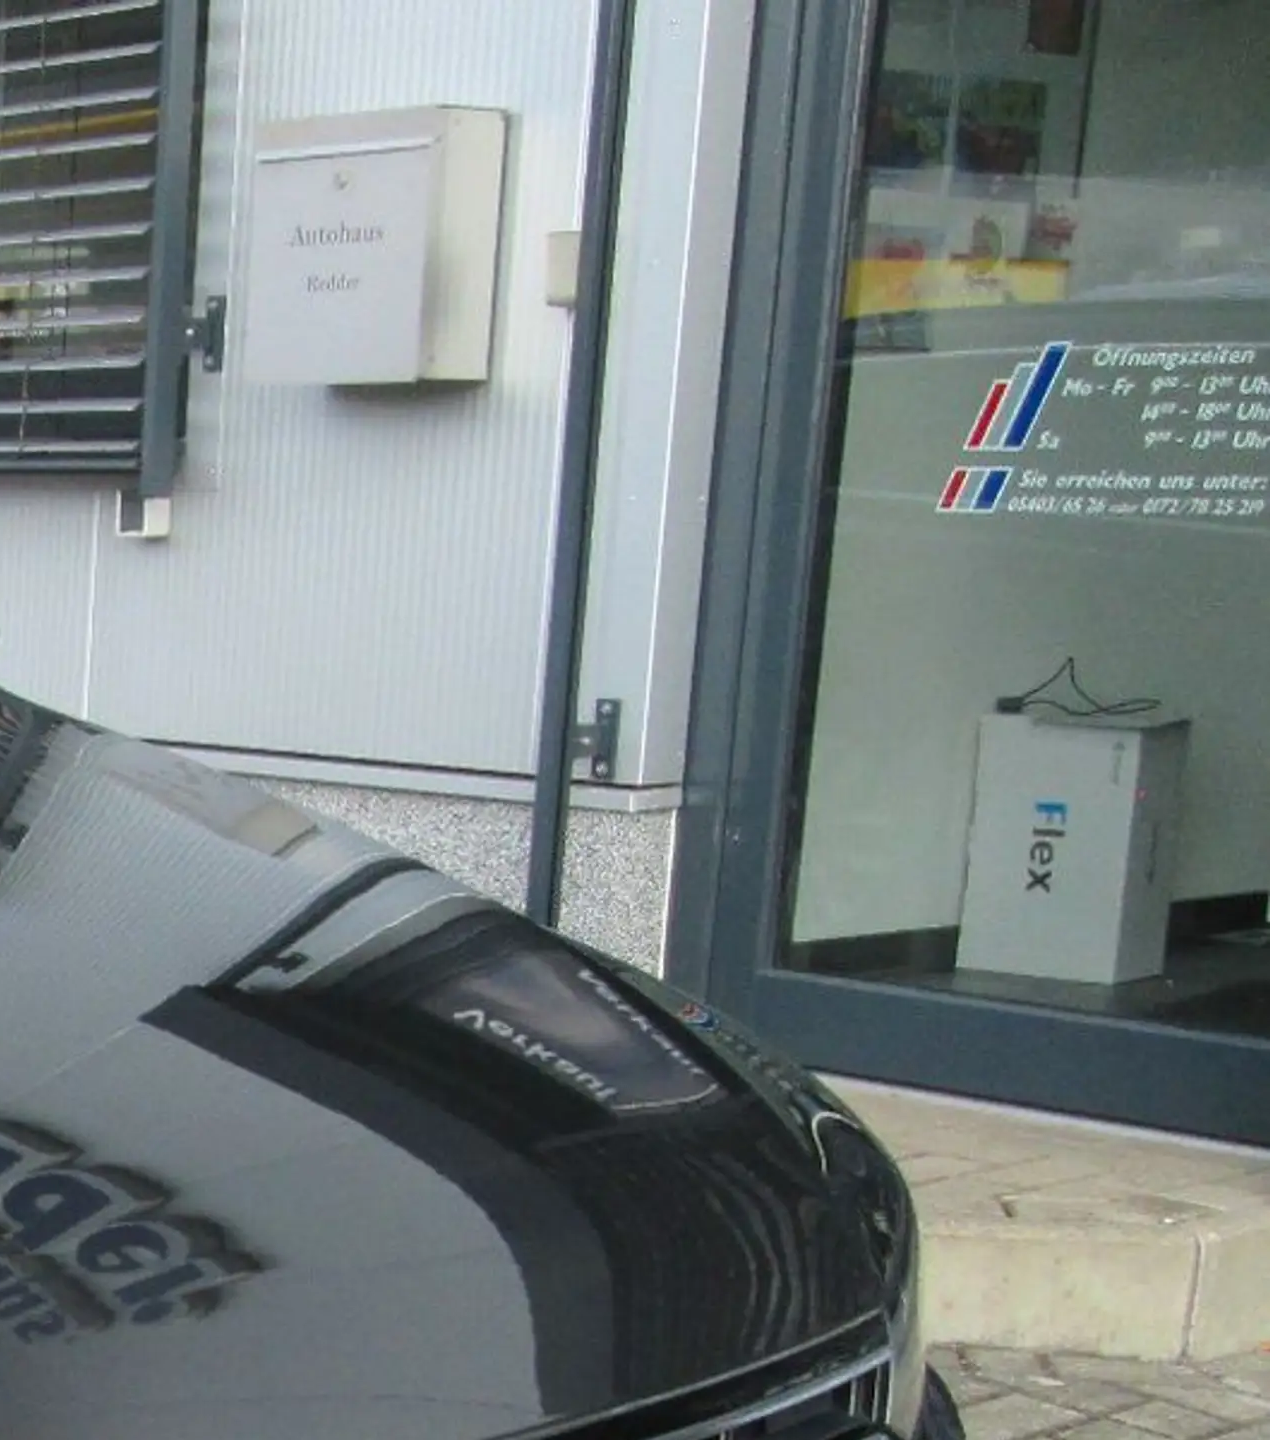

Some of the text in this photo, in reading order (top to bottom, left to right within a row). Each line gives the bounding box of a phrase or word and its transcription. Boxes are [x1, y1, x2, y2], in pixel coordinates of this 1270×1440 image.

[289, 221, 384, 247] Autohaus
[1062, 378, 1092, 396] Mo
[1112, 378, 1135, 396] Fr
[1239, 376, 1270, 395] Uh
[1018, 470, 1047, 489] Sie
[1055, 470, 1151, 490] erreichen
[1159, 475, 1195, 490] uns
[1026, 801, 1068, 893] Flex
